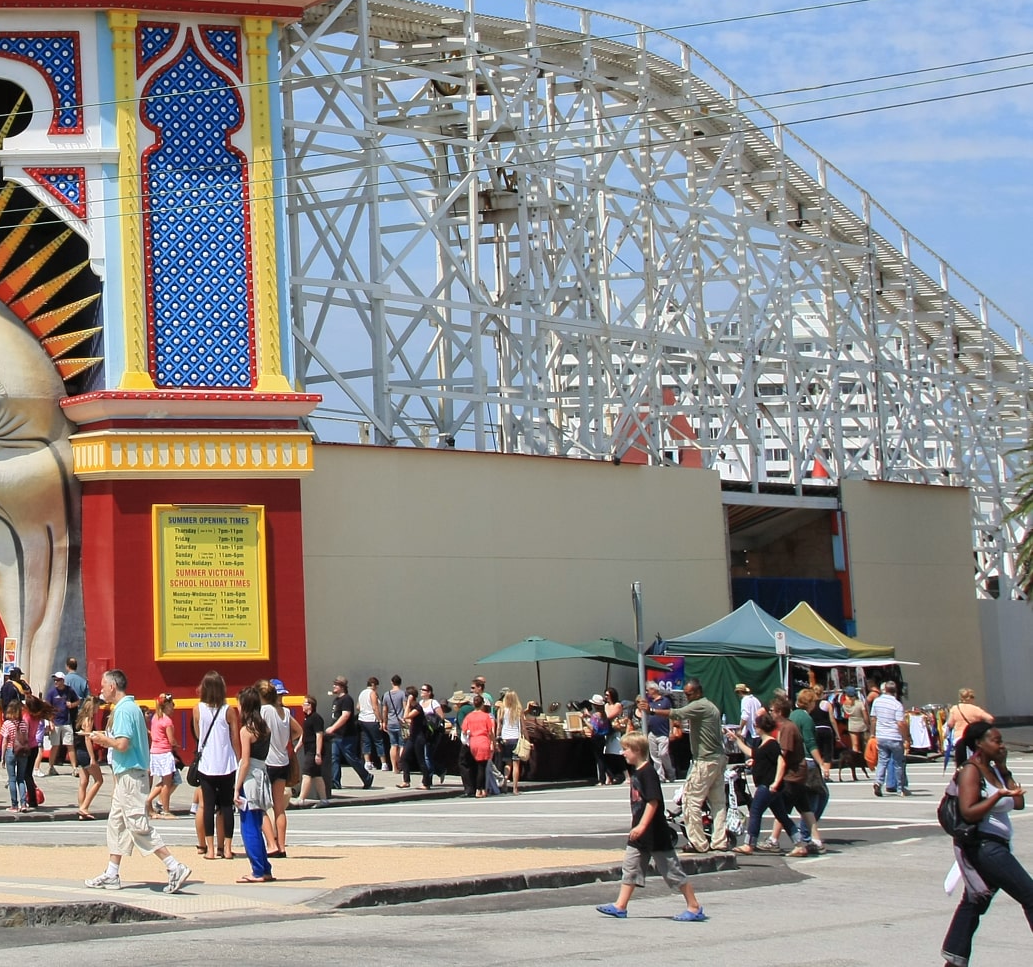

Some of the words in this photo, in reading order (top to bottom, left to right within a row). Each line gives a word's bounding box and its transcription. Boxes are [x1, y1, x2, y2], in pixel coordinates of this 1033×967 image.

[168, 516, 197, 524] SUMMER
[199, 516, 228, 524] OPENING
[230, 517, 249, 525] TIMES
[175, 569, 206, 577] SUMMER
[208, 569, 245, 577] VICTORIAN
[169, 579, 197, 587] SCHOOL
[199, 579, 228, 587] HOLIDAY
[230, 579, 251, 587] TIMES
